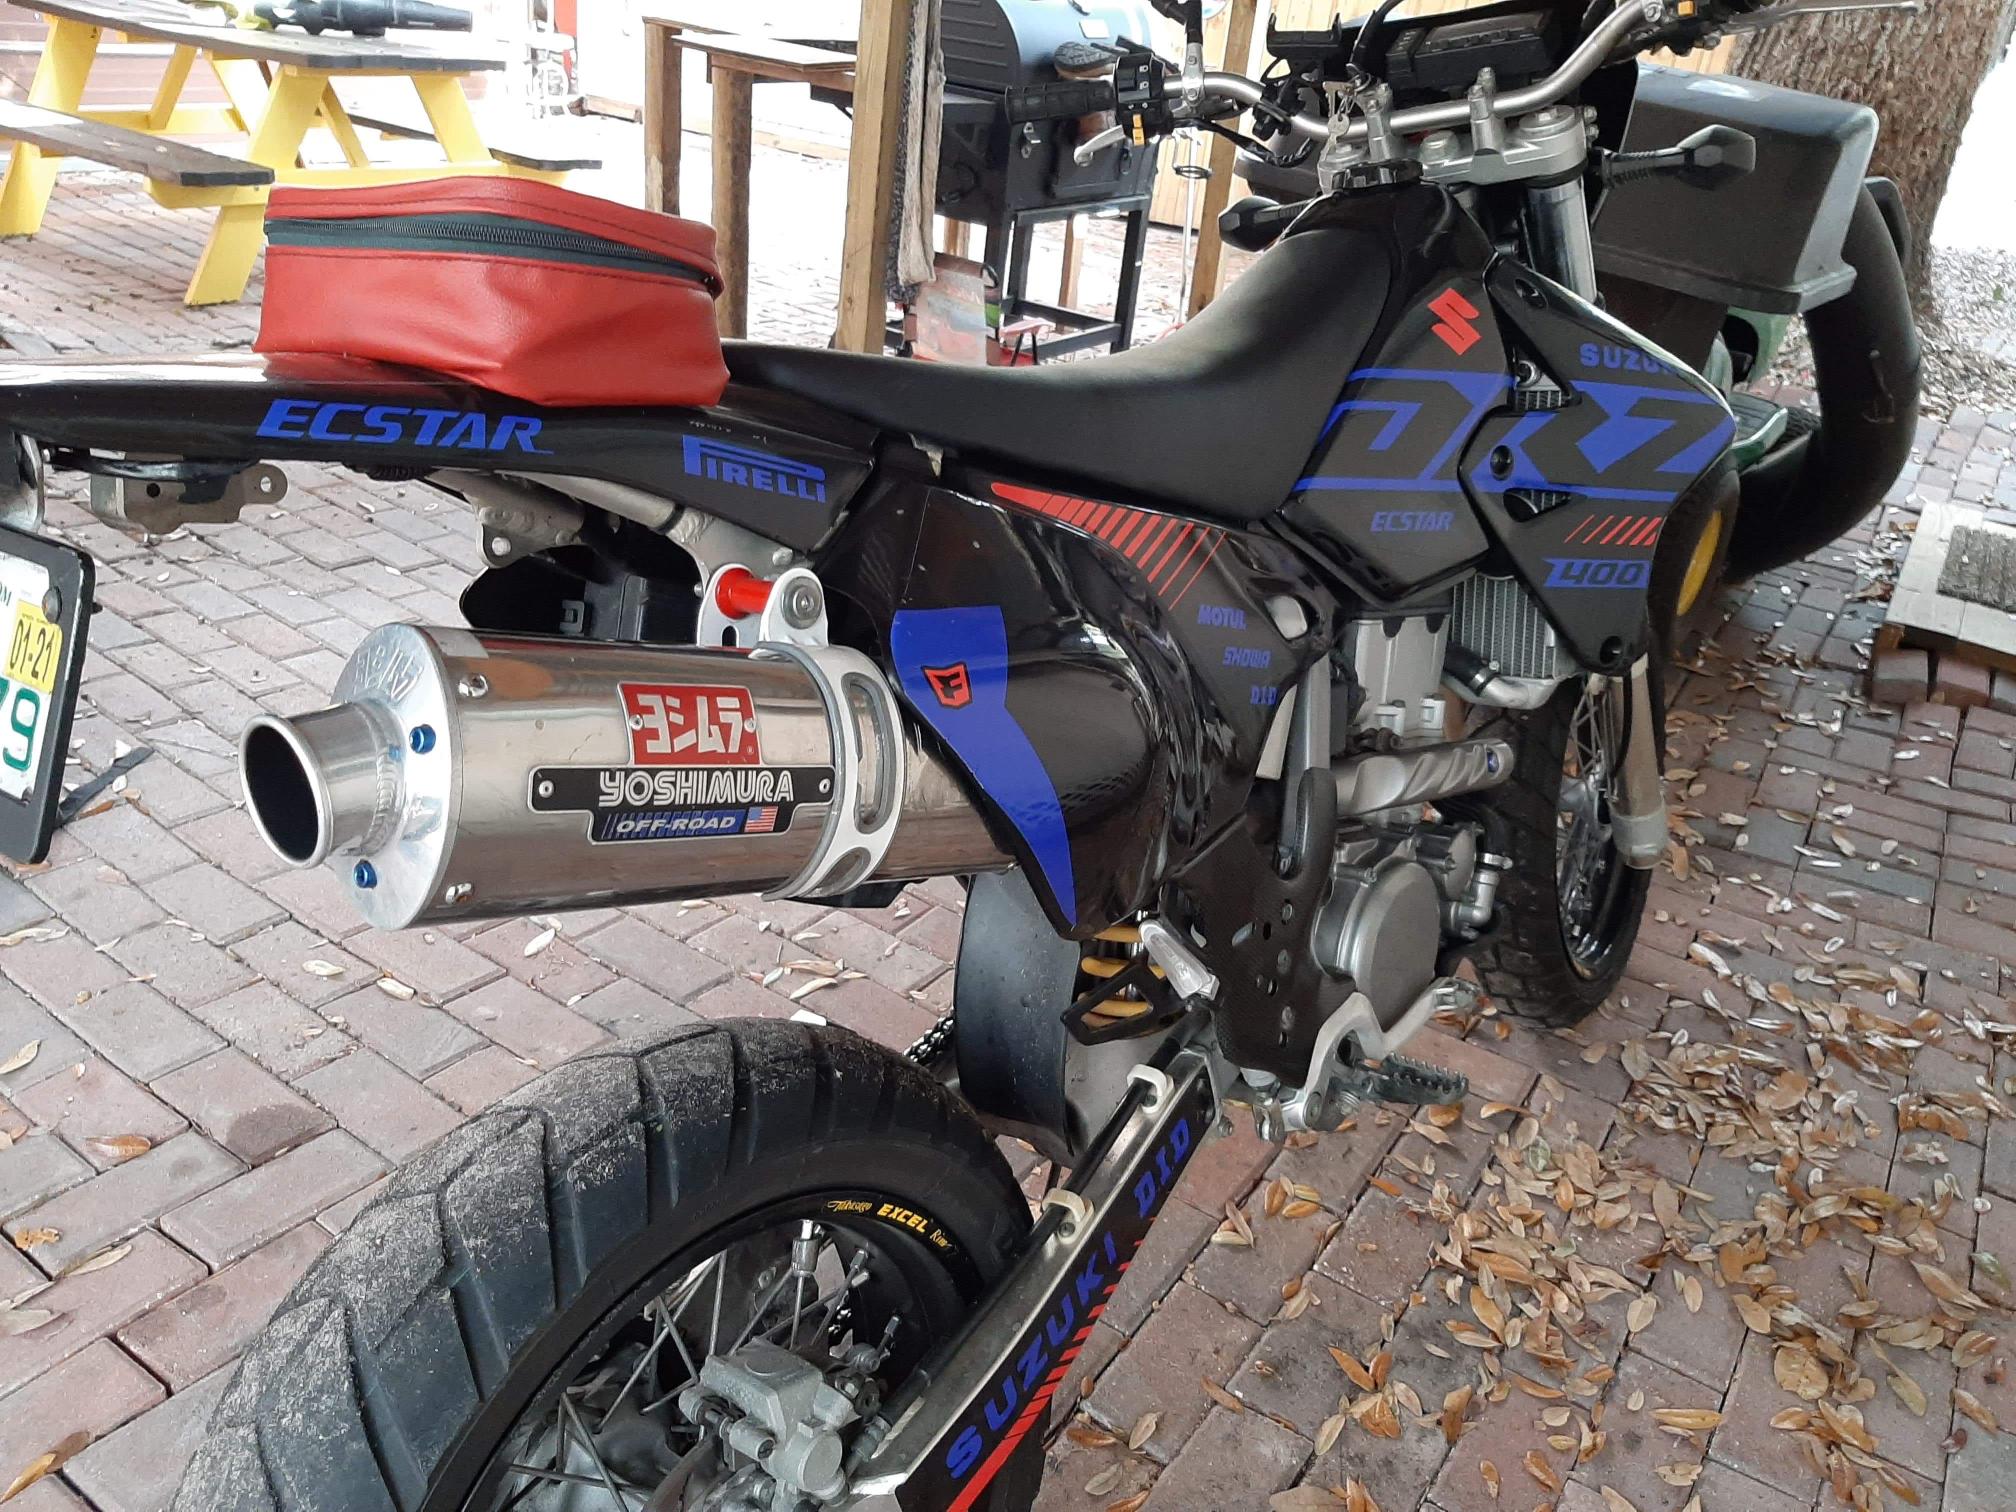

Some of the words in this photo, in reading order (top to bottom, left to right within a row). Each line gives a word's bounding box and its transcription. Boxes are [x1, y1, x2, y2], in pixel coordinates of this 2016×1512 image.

[1579, 342, 1673, 375] SUZU
[255, 399, 554, 455] ECSTAR
[682, 434, 825, 502] PIRELLI
[1370, 510, 1455, 532] ECSTAR
[1560, 562, 1649, 586] 400
[1197, 604, 1246, 629] MOTUL
[10, 618, 55, 682] 01-21
[1223, 646, 1273, 668] SHOWA
[0, 676, 41, 773] 9
[599, 770, 794, 807] YOSHIMURA
[616, 816, 737, 833] OFF-ROAD
[876, 1203, 929, 1234] EXCEL
[945, 1231, 1119, 1479] SUZUKI
